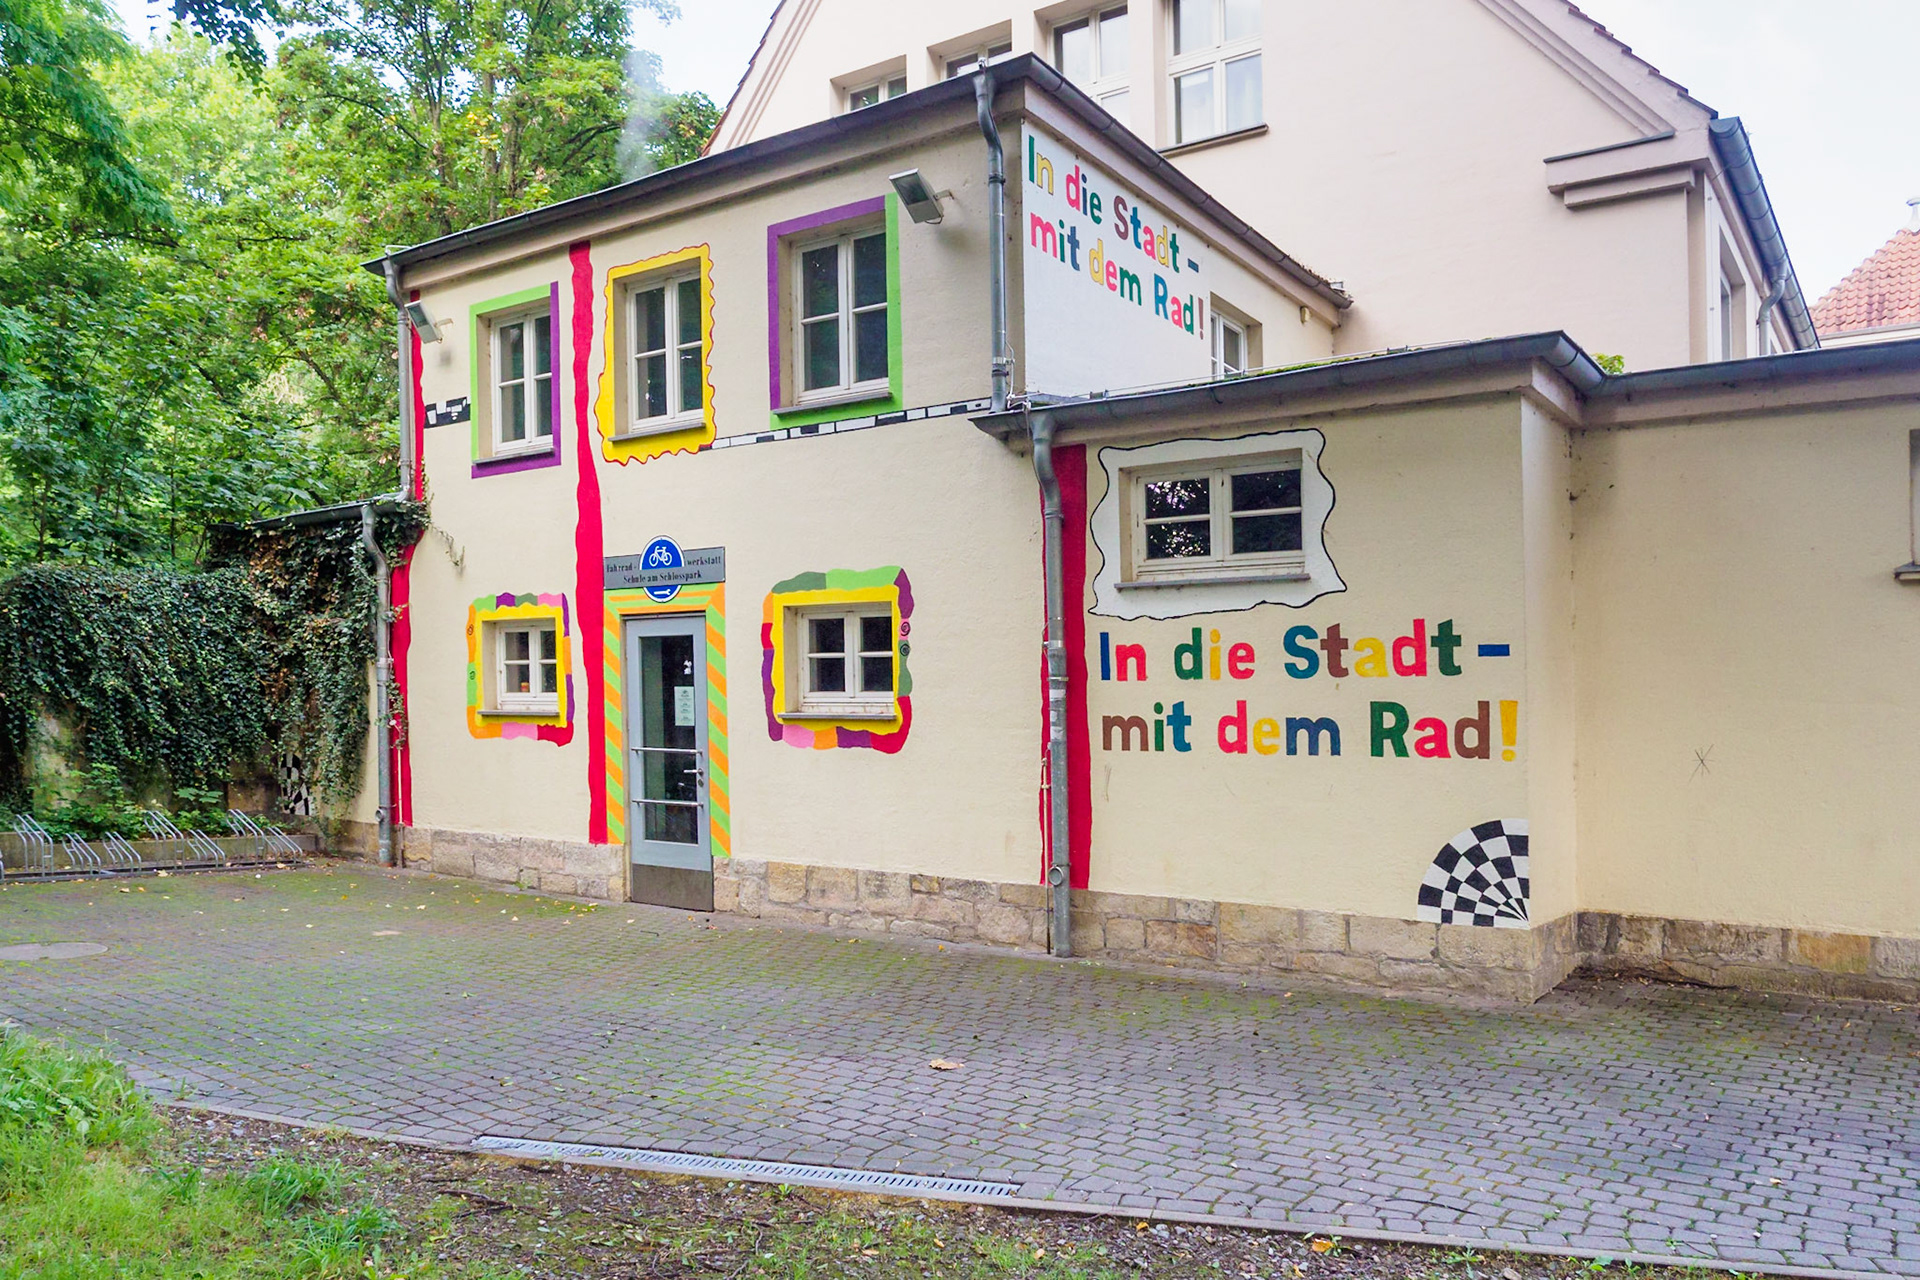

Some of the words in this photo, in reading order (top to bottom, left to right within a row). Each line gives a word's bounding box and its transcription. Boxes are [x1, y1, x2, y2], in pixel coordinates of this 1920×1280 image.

[1029, 135, 1053, 195] In
[1066, 165, 1102, 224] die
[1030, 212, 1080, 271] mit
[1089, 238, 1142, 306] dem
[1154, 273, 1204, 340] Rad!
[623, 573, 646, 584] Schule
[660, 570, 702, 582] Schlosspark
[1100, 632, 1147, 681] In
[1174, 627, 1255, 680] die
[1102, 701, 1192, 752] mit
[1217, 700, 1341, 756] dem
[1370, 700, 1518, 762] Rad!
